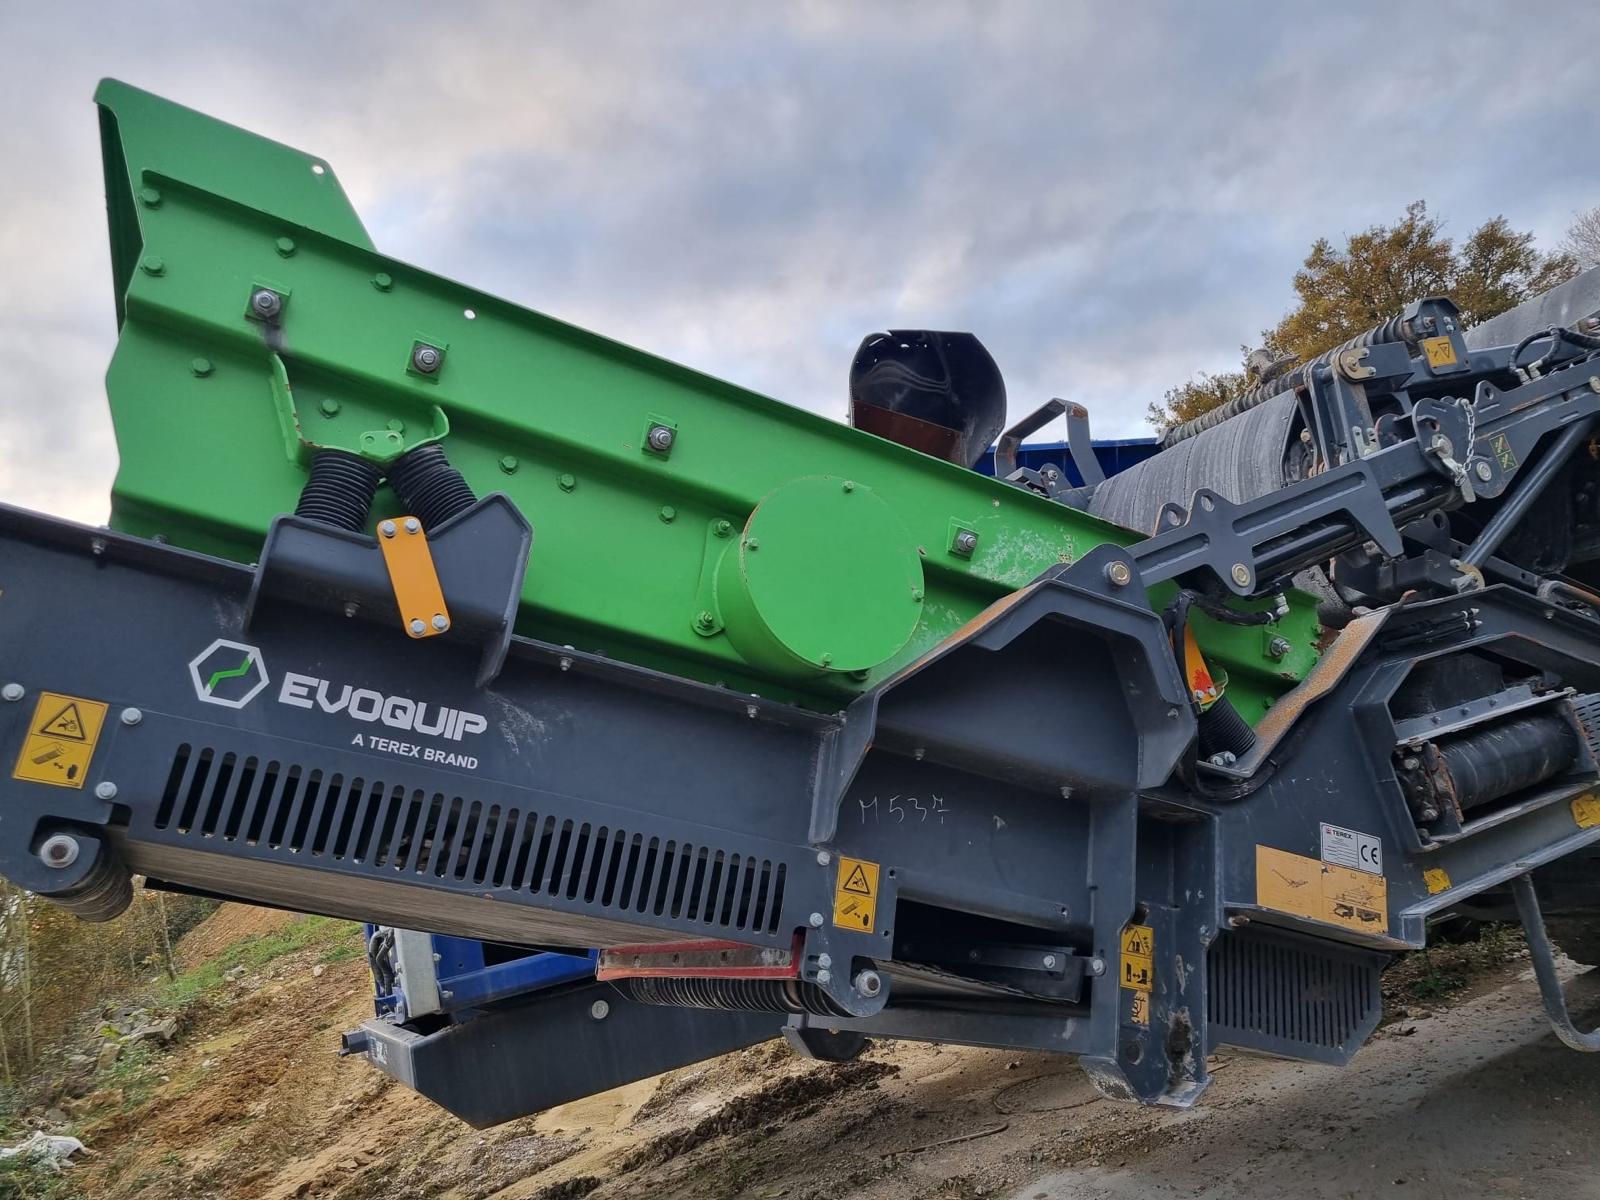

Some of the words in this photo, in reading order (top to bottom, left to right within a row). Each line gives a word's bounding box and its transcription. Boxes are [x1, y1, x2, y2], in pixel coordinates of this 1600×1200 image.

[278, 671, 488, 742] EVOQUIP
[351, 733, 365, 747] A
[369, 735, 421, 759] TEREX
[423, 747, 479, 770] BRAND
[1332, 829, 1353, 840] TEREX
[1360, 844, 1379, 865] CE
